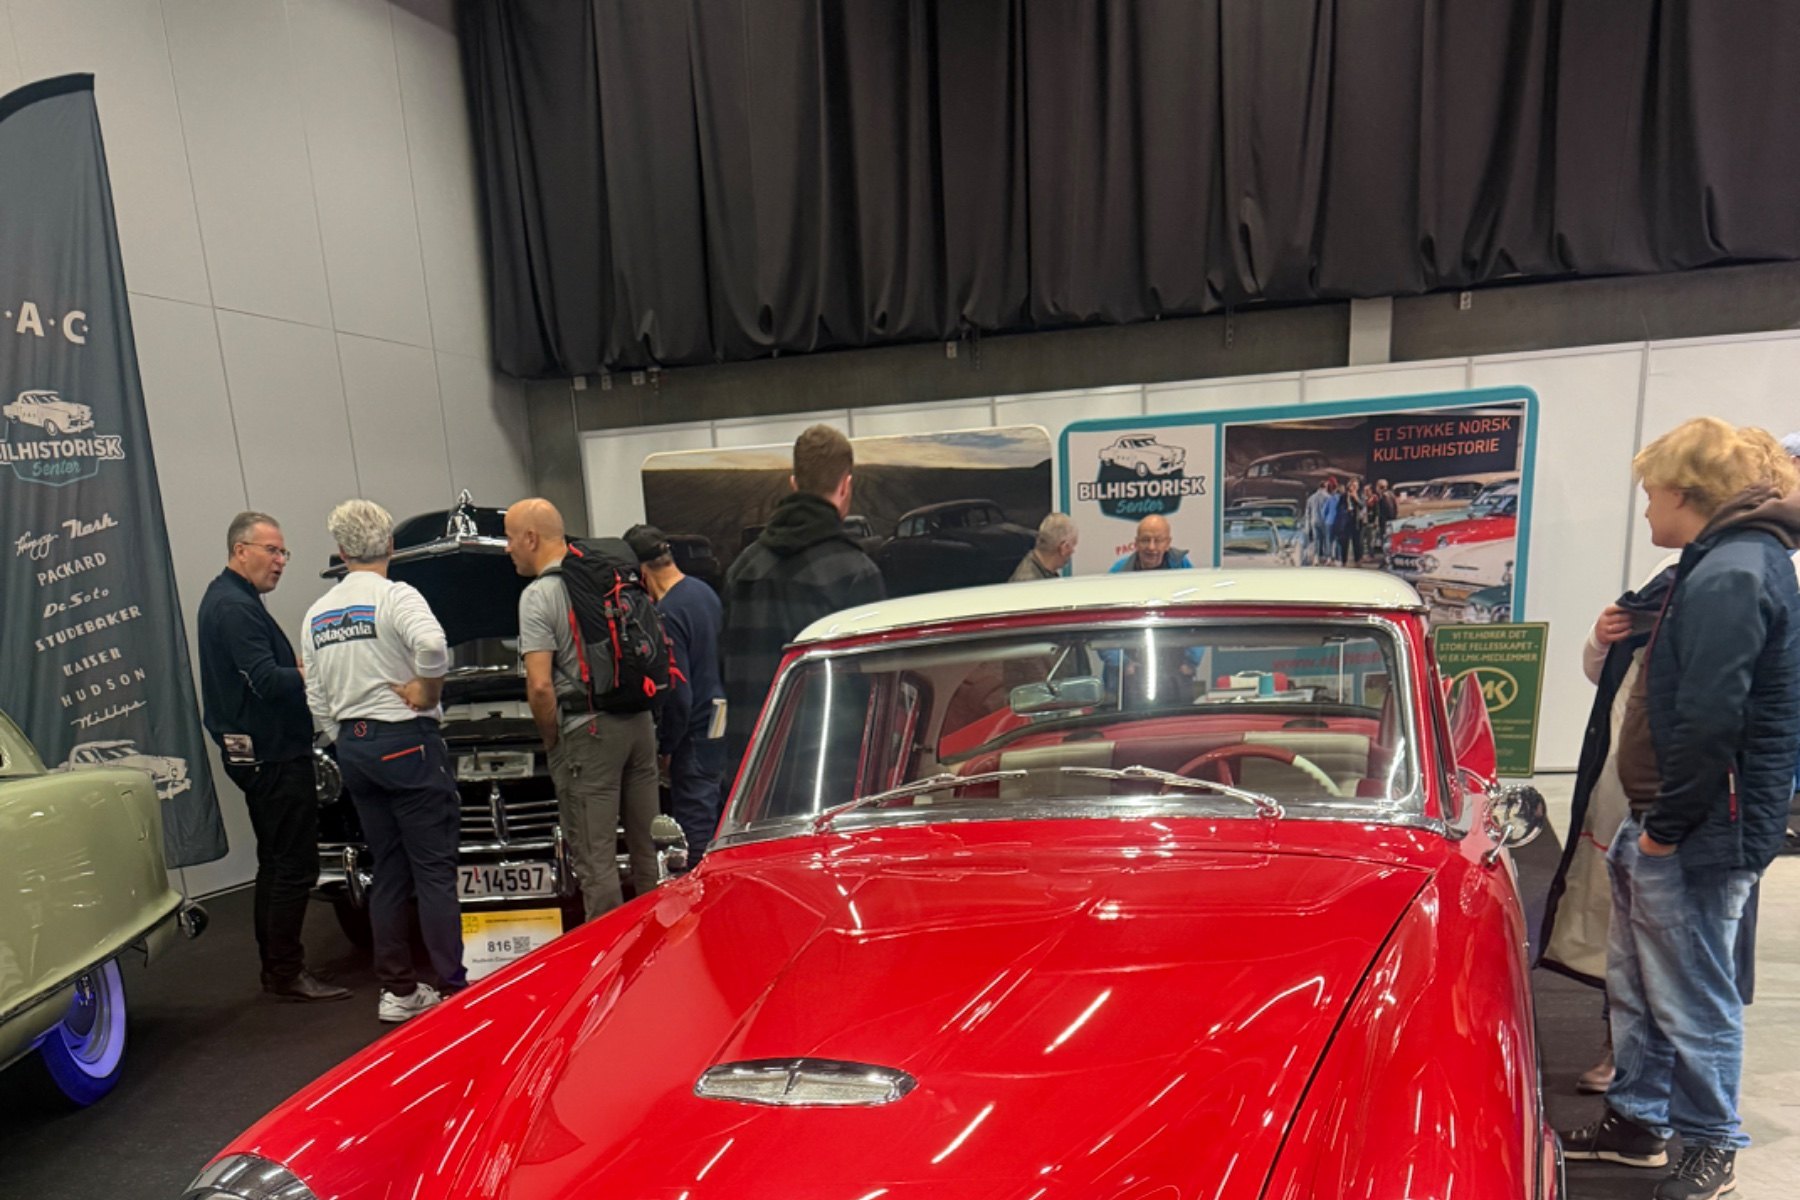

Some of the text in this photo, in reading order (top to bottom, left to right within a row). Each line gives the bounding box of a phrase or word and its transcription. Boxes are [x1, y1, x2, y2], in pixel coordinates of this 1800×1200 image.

[1373, 417, 1512, 442] ET STYKKE NORSK
[0, 437, 122, 462] ILHISTORISK
[1372, 438, 1500, 462] KULTURHISTORIE
[32, 461, 81, 477] Senter
[1078, 477, 1206, 500] BILHISTORISK
[1115, 499, 1165, 514] Senter
[62, 512, 118, 539] Nash
[37, 552, 107, 587] PACKARD
[35, 605, 142, 652] STUDEBAKER
[315, 622, 373, 648] patagonia
[1508, 630, 1528, 639] DET
[62, 647, 122, 677] KAISER
[61, 667, 146, 708] HUDSON
[461, 867, 544, 894] Z-14597
[487, 941, 512, 953] 816
